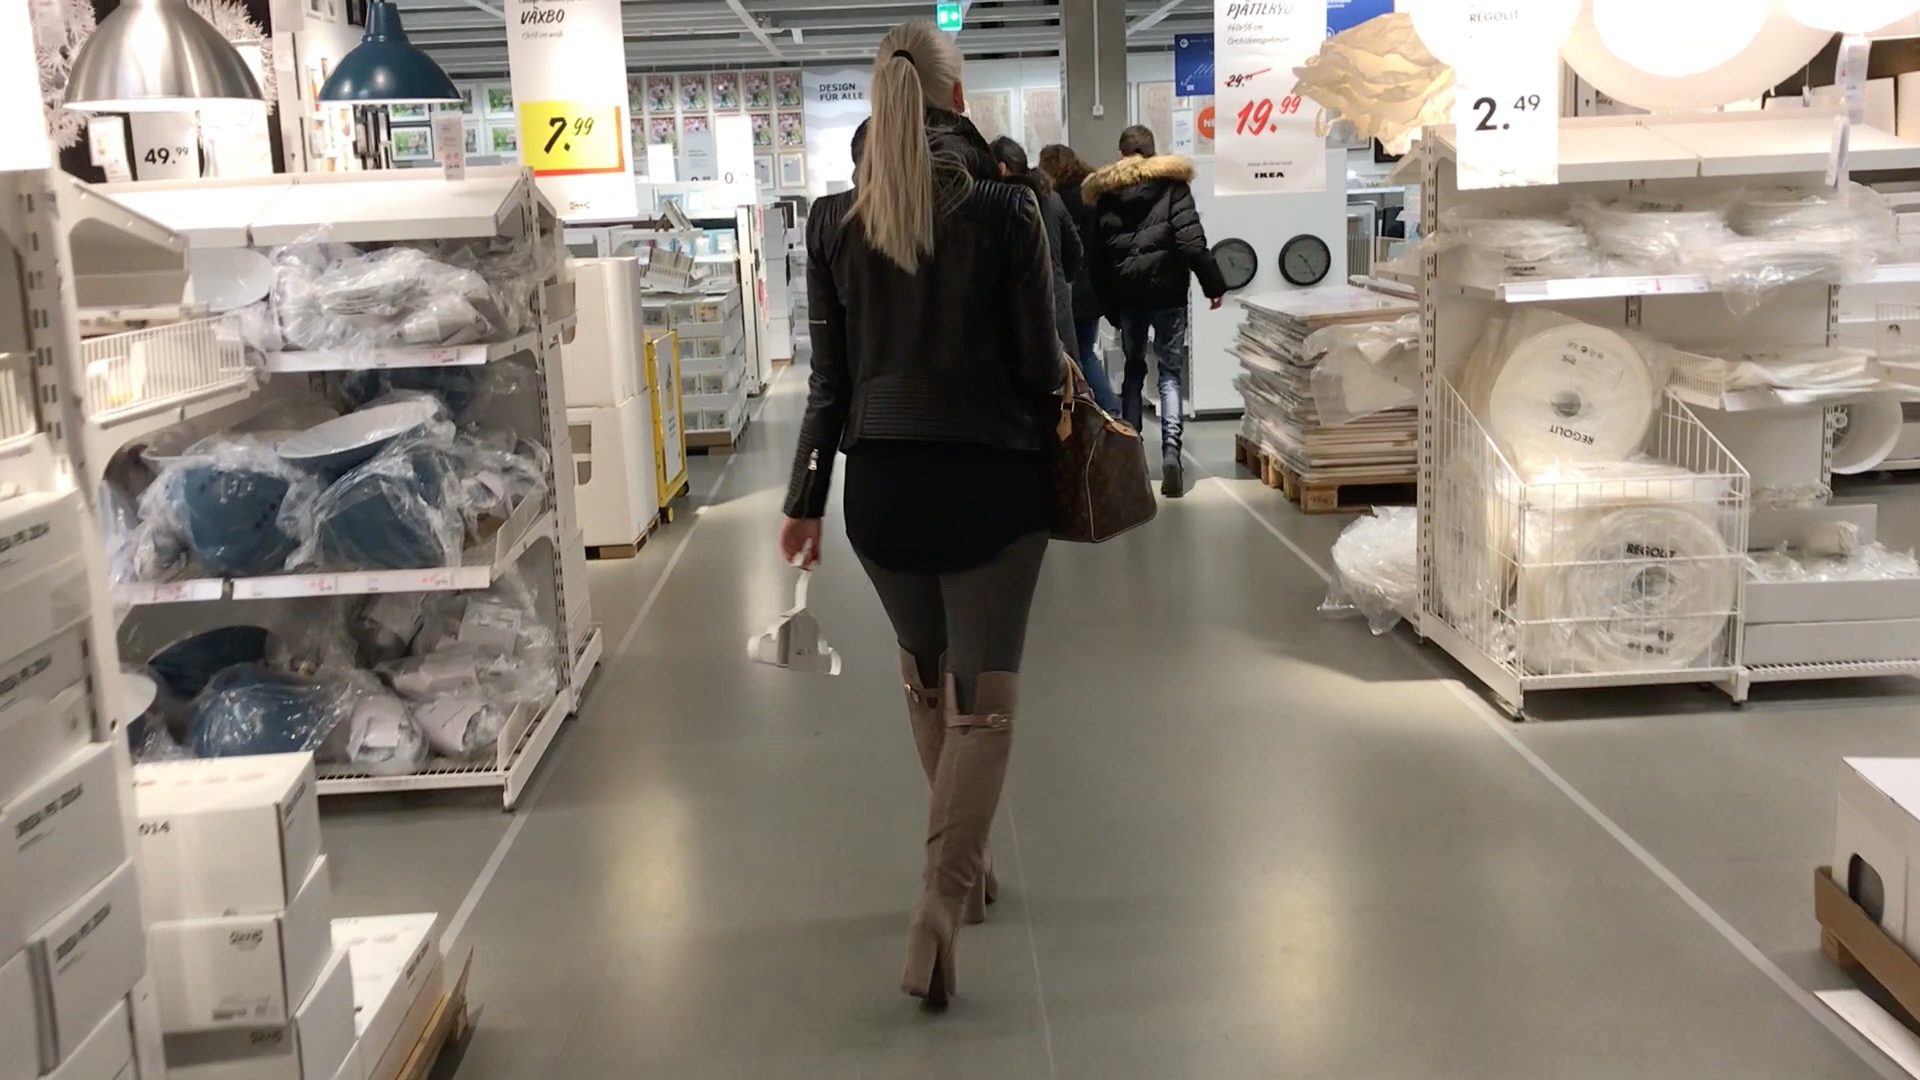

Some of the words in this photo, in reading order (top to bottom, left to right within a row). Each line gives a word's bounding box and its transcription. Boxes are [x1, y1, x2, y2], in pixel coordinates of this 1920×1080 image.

[521, 6, 565, 24] VÄXBO
[1469, 10, 1519, 23] REGOLIT
[819, 83, 855, 92] DESIGN
[820, 92, 838, 101] FÜR
[841, 92, 864, 100] ALLE
[1254, 171, 1285, 179] IKEA
[1549, 424, 1595, 446] REGOLIT
[1626, 543, 1676, 559] REGOLIT
